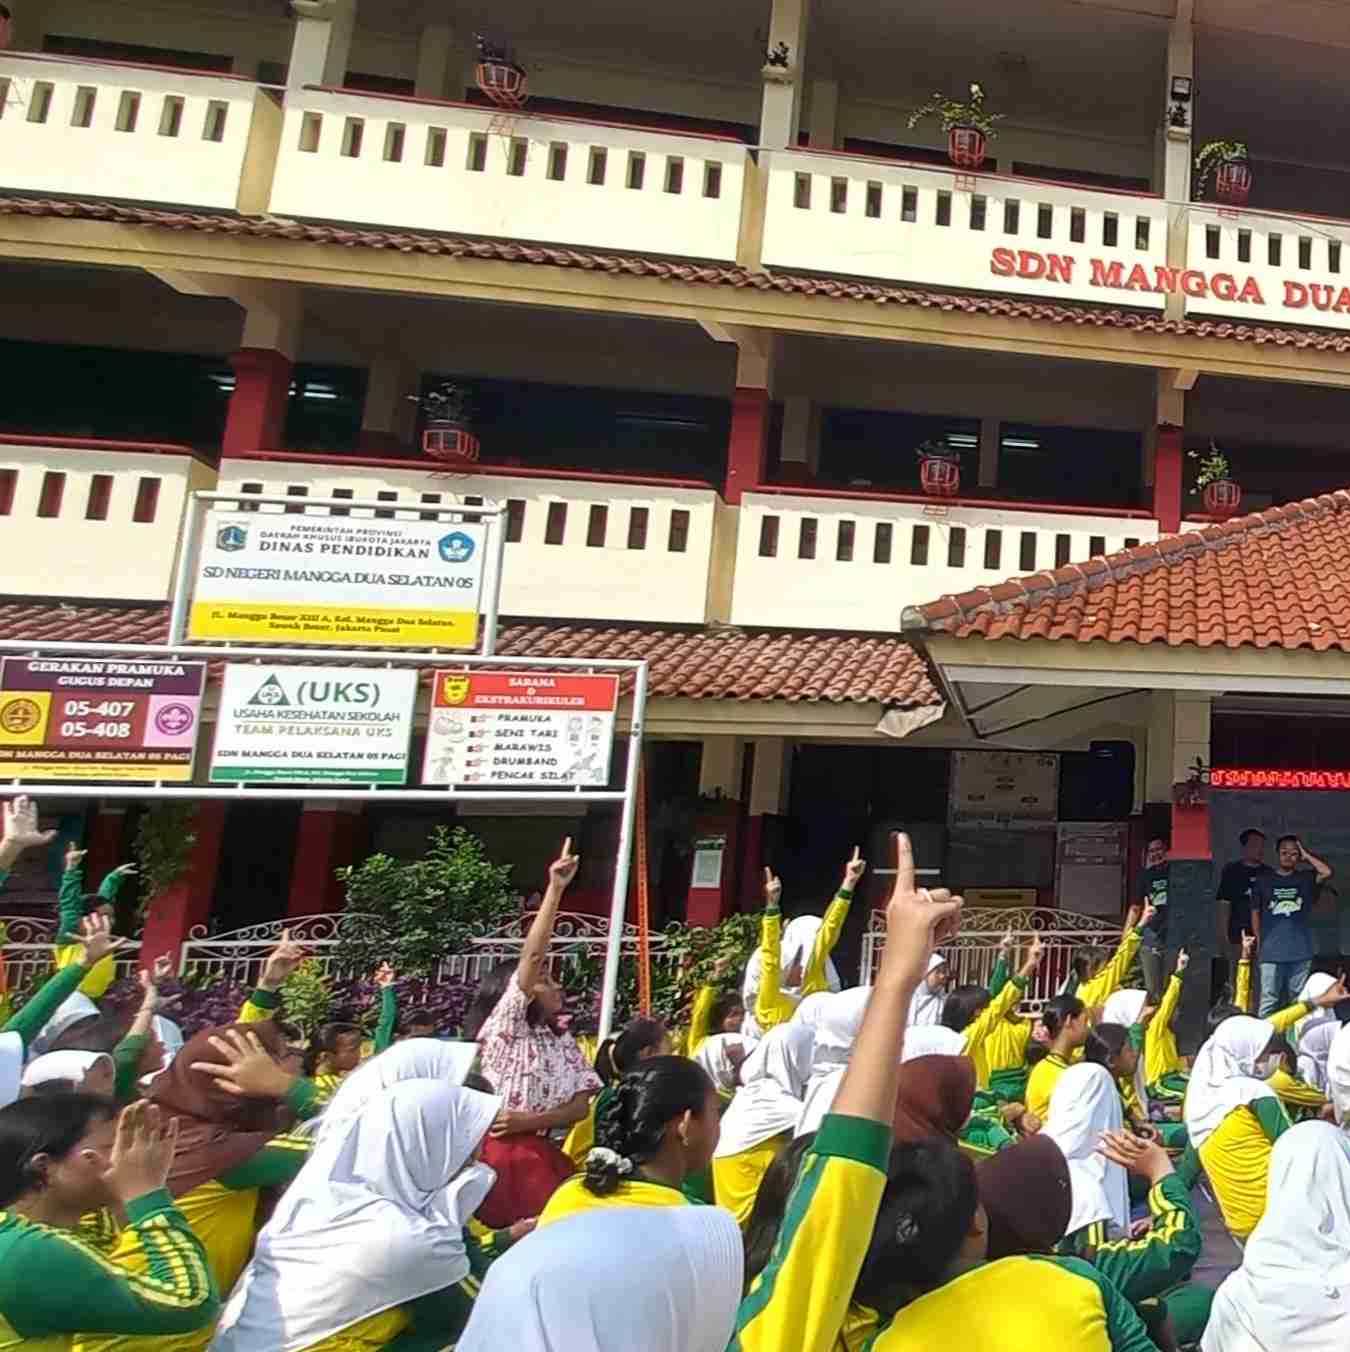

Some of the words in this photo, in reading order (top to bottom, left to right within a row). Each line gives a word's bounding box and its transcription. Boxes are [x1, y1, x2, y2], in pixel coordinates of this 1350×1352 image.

[990, 247, 1074, 283] SDN
[1090, 258, 1265, 305] MANGGA
[259, 541, 314, 553] DINAS
[319, 544, 431, 558] PENDIDIKAN
[203, 566, 224, 578] SD
[225, 567, 280, 580] NEGERI
[283, 570, 354, 583] MANGGA
[354, 572, 386, 585] DUA
[387, 574, 455, 588] SELATAN
[27, 661, 104, 674] GERAKAN
[107, 664, 185, 675] PRAMUKA
[58, 676, 105, 686] GUGUS
[107, 677, 154, 688] DEPAN
[297, 681, 381, 707] (UKS)
[64, 701, 135, 717] 05-407
[233, 709, 275, 719] USAHA
[277, 710, 346, 720] KESEHATAN
[347, 711, 400, 722] SEKOLAH
[497, 714, 553, 723] PRAMUKA
[61, 722, 131, 738] 05-408
[234, 724, 273, 735] TEAM
[279, 725, 361, 737] PELAKSANA
[366, 727, 393, 737] UKS
[495, 729, 525, 738] SENI
[530, 730, 559, 738] TARI
[494, 744, 553, 752] MARAWIS
[15, 751, 66, 760] MANGGA
[69, 752, 93, 760] DUA
[95, 752, 146, 760] SELATAN
[241, 750, 288, 758] MANGGA
[291, 751, 314, 759] DUA
[316, 752, 364, 760] SELATAN
[493, 757, 558, 766] DRUMBAND
[491, 770, 535, 780] PENCAK
